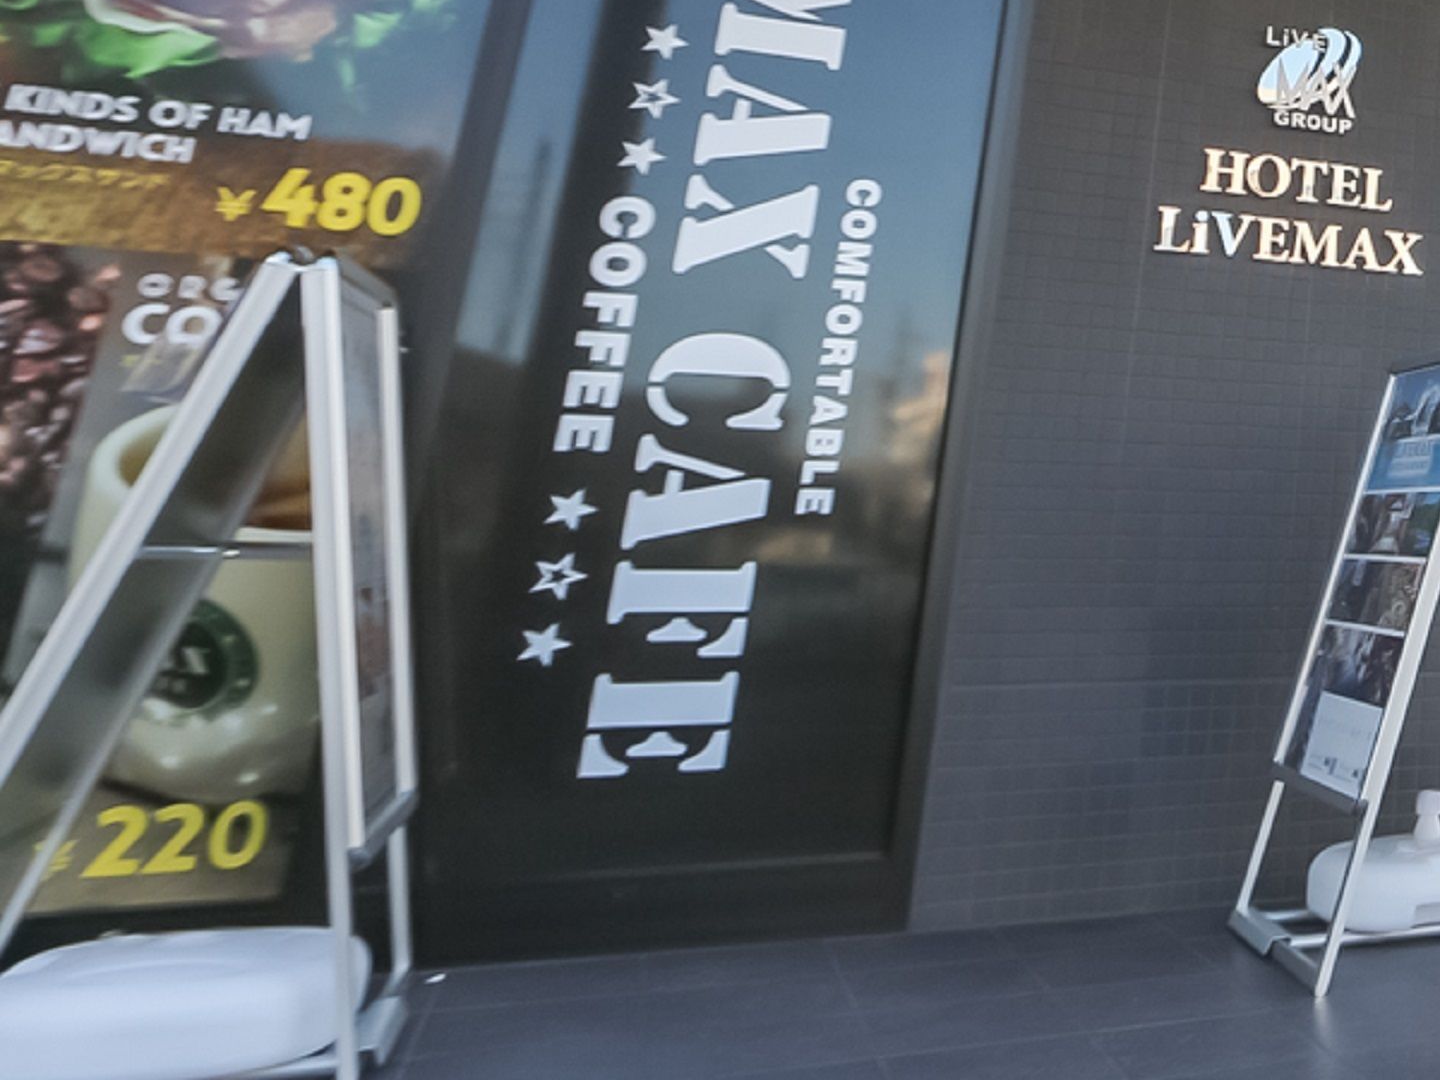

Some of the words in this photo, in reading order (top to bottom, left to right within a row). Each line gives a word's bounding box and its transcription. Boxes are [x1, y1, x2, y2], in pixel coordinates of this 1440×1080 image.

[4, 83, 141, 123] KINDS
[148, 99, 214, 130] OF
[216, 105, 313, 141] HAM
[1200, 148, 1394, 212] HOTEL
[1273, 111, 1353, 135] GROUP
[553, 196, 656, 454] COFFEE
[795, 179, 882, 516] COMFORTABLE
[576, 332, 791, 779] CAFE
